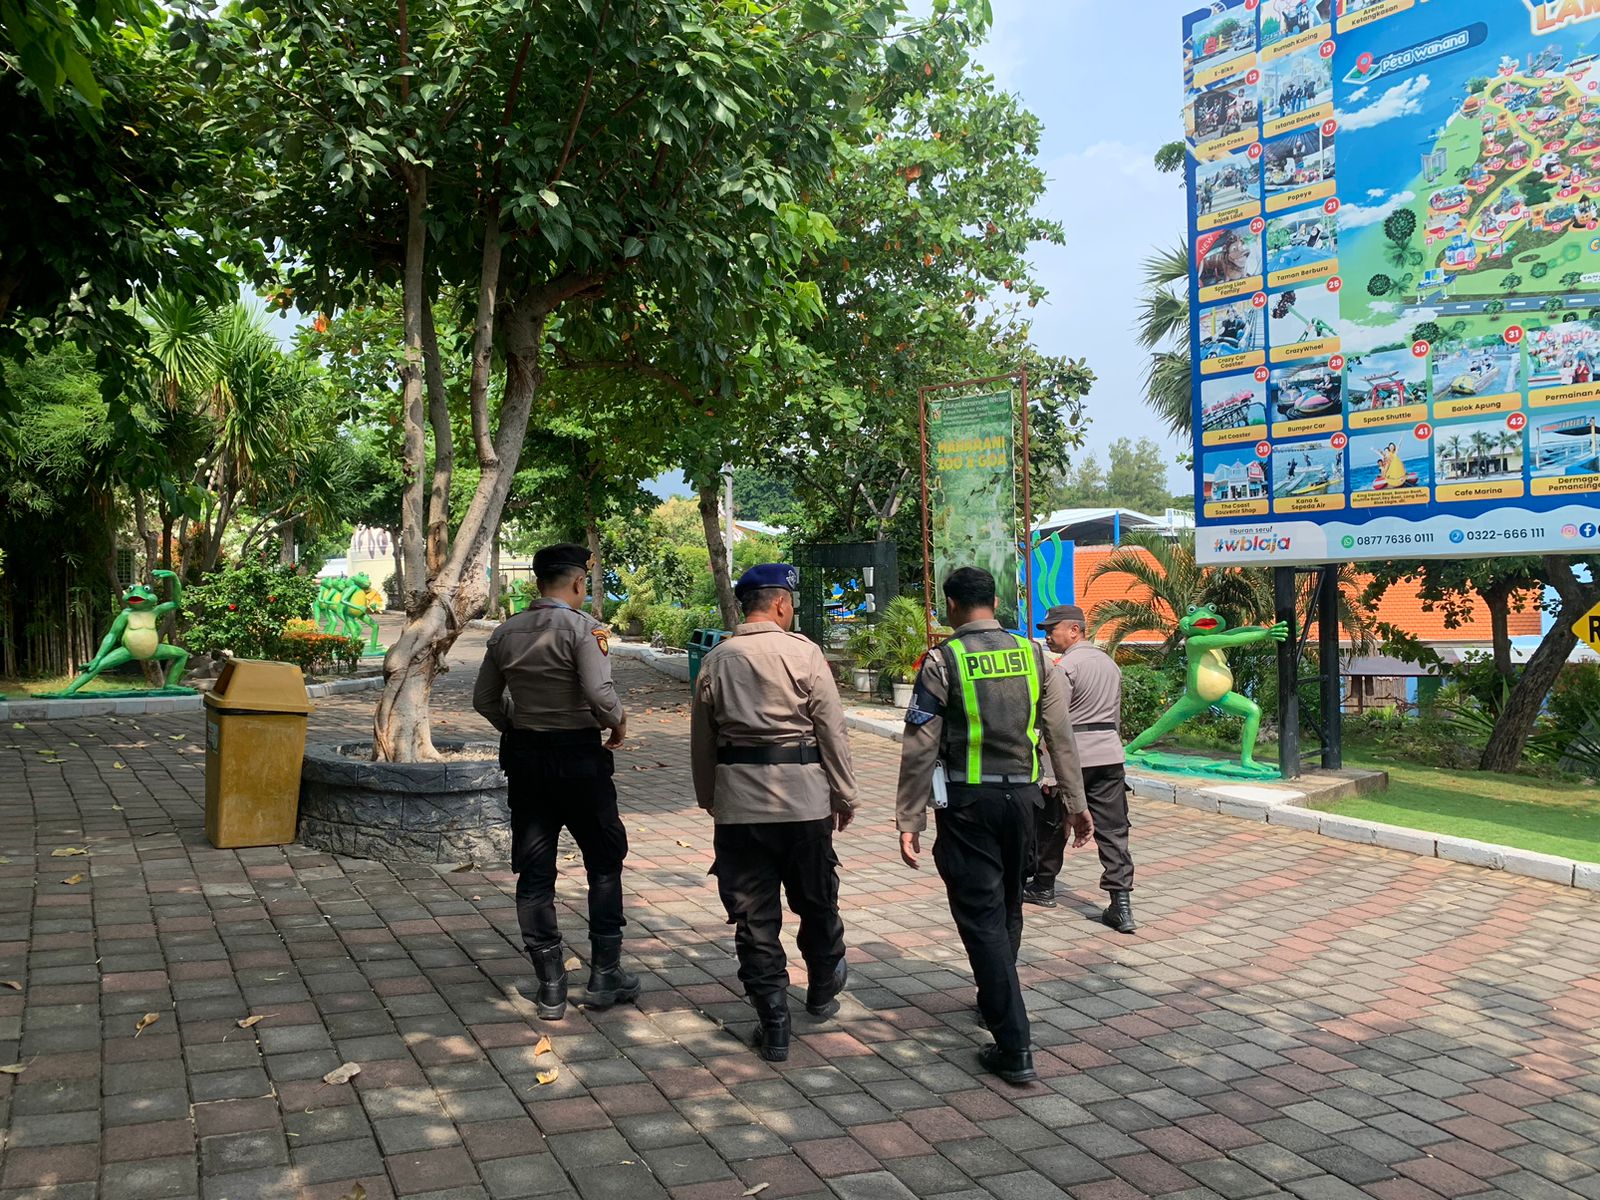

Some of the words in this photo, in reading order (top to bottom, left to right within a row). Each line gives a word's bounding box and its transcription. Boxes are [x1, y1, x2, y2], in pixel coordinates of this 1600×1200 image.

[1352, 4, 1398, 26] Ketangkasan
[1363, 4, 1384, 15] Arena
[1273, 40, 1295, 53] Rumah
[1296, 32, 1318, 45] Kucing
[1322, 44, 1332, 54] 13
[1214, 66, 1234, 77] E-Bike
[1275, 120, 1295, 130] Istana
[1296, 111, 1320, 123] Boneka
[1325, 122, 1334, 131] 17
[1227, 136, 1244, 145] Cross
[1287, 190, 1312, 201] Popeye
[1218, 208, 1239, 217] Sarang
[1200, 234, 1214, 255] NEW
[1277, 272, 1300, 281] Taman
[1301, 265, 1328, 276] Berburu
[1215, 282, 1234, 291] Spring
[1220, 287, 1240, 296] Family
[1285, 343, 1324, 355] CrazyWheel
[1415, 345, 1426, 353] 30
[1218, 356, 1234, 365] Crazy
[1220, 360, 1244, 369] Coaster
[1545, 390, 1594, 401] Permainan
[1452, 404, 1473, 412] Balok
[1474, 401, 1501, 412] Apung
[1363, 415, 1385, 424] Space
[1386, 412, 1412, 420] Shuttle
[1510, 417, 1523, 425] 42
[1287, 424, 1313, 433] Bumper
[937, 456, 962, 470] ZOO
[978, 453, 1007, 468] GOA
[1558, 476, 1599, 485] Dermaga
[1357, 536, 1382, 545] 0877
[1385, 534, 1411, 544] 7636
[1415, 533, 1434, 543] 0111
[1467, 528, 1527, 540] 0322-666
[1531, 528, 1545, 538] 111
[1214, 534, 1291, 554] #wblaja
[965, 651, 1029, 677] POLISI
